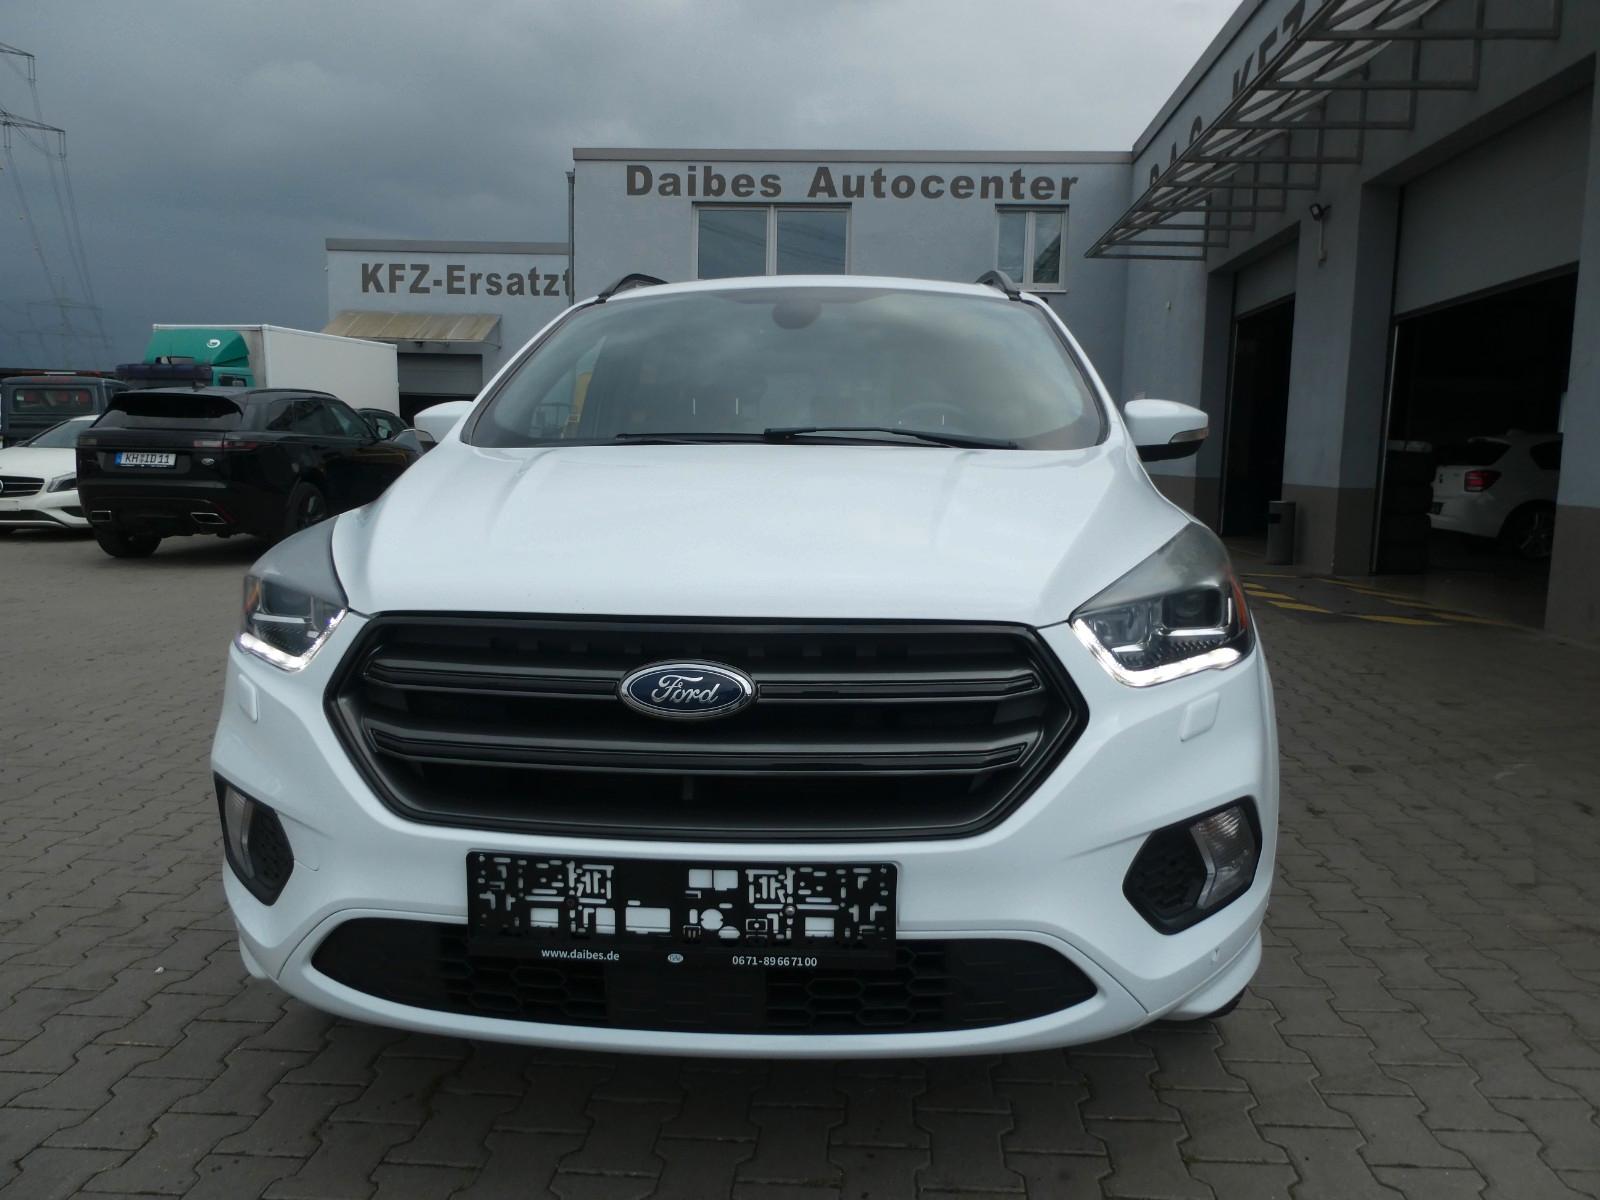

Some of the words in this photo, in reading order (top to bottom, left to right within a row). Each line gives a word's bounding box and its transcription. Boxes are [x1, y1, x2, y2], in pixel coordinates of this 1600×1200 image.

[626, 165, 782, 197] Daibes
[808, 167, 1079, 200] Autocenter
[651, 674, 721, 703] Ford
[541, 949, 620, 961] www.daibes.de
